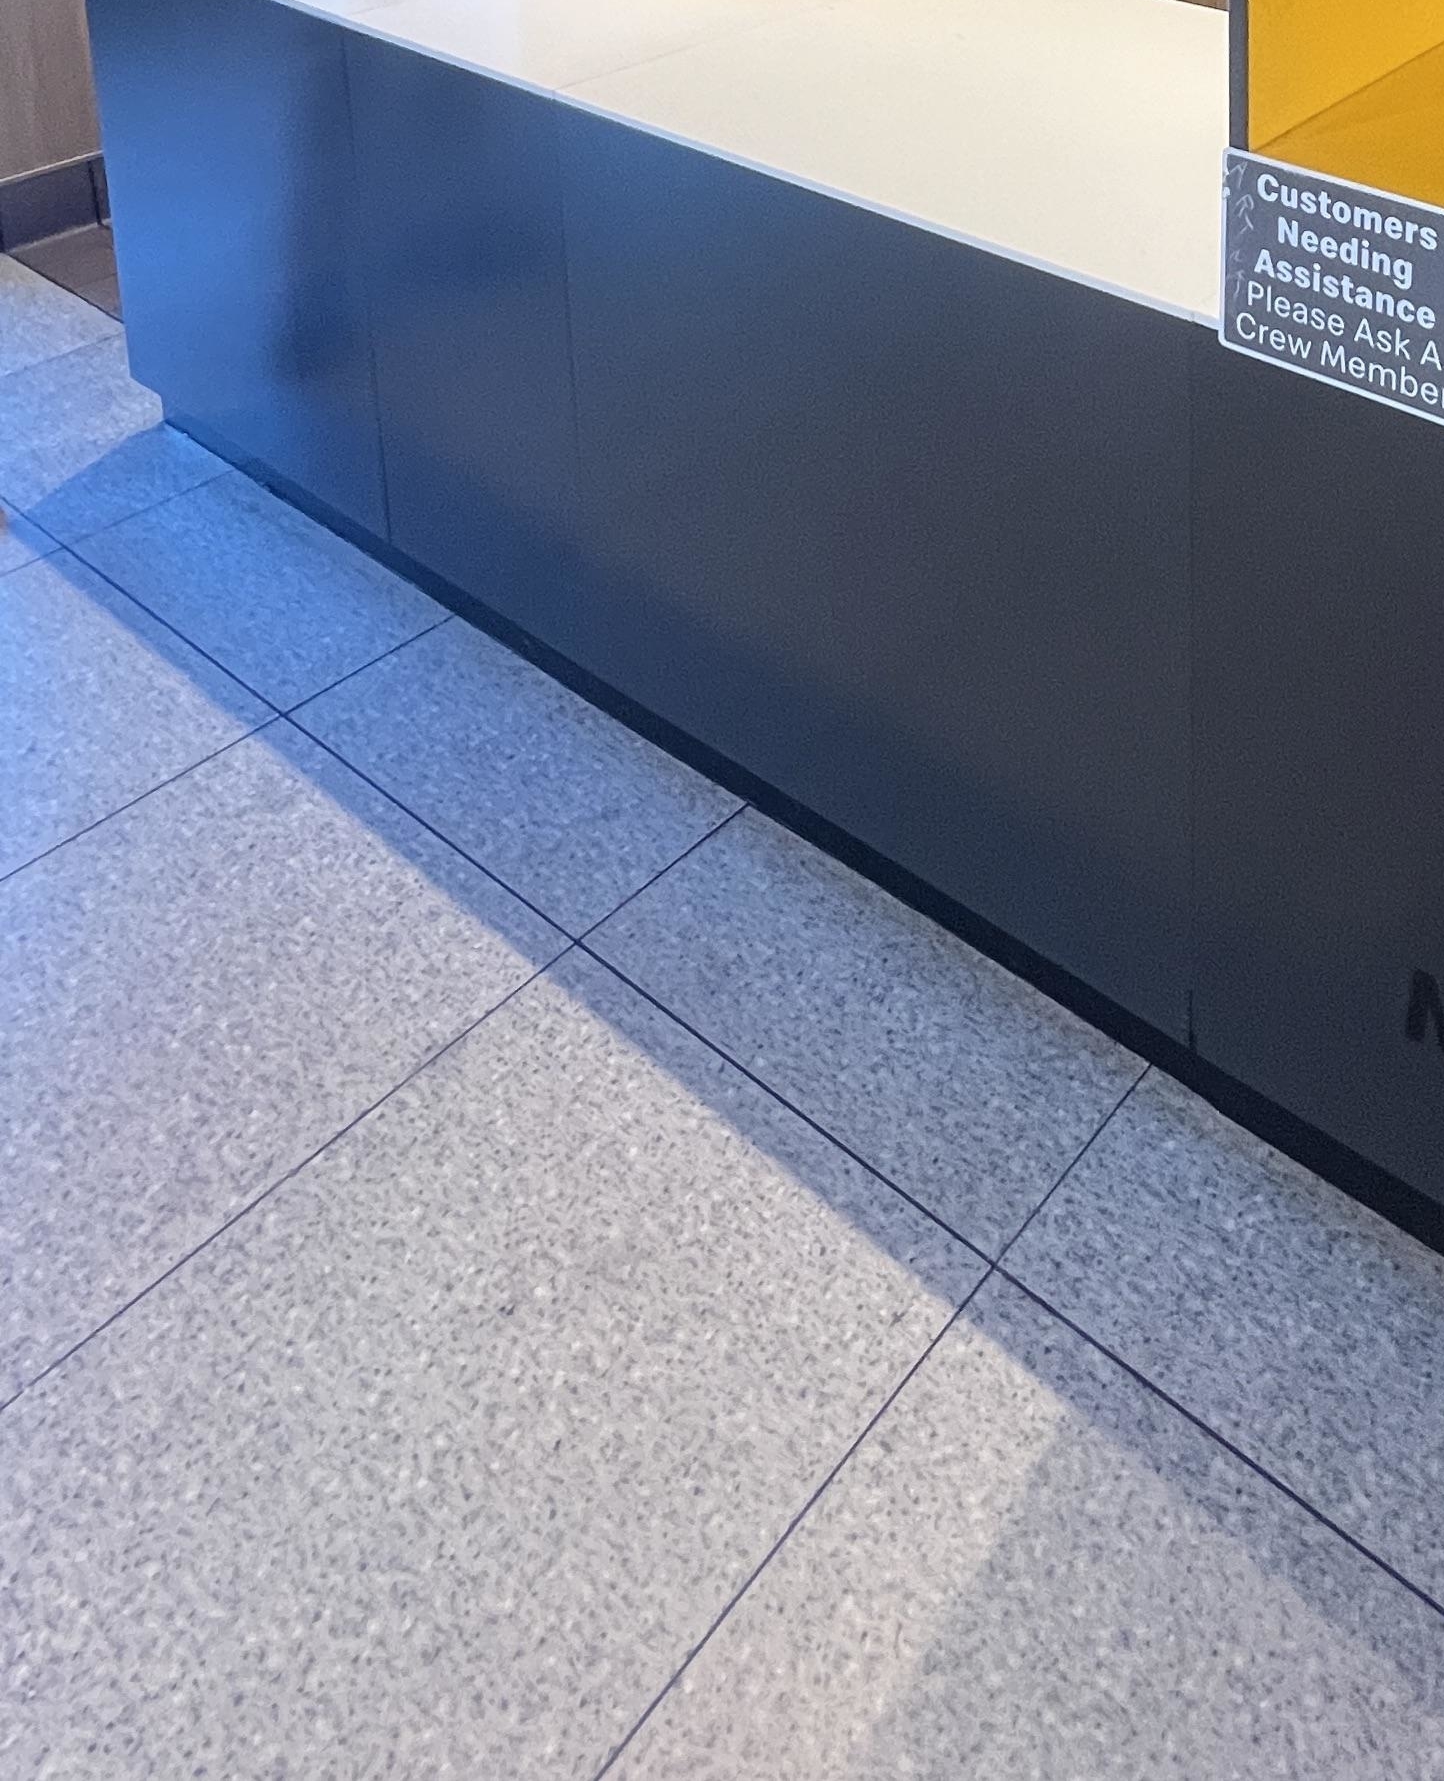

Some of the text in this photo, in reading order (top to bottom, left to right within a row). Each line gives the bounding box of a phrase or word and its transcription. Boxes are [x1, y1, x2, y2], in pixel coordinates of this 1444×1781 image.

[1257, 173, 1438, 250] Customers
[1253, 248, 1436, 330] Assistance
[1277, 216, 1413, 290] Needing
[1236, 312, 1312, 359] Crew
[1247, 280, 1442, 371] Please Ask A
